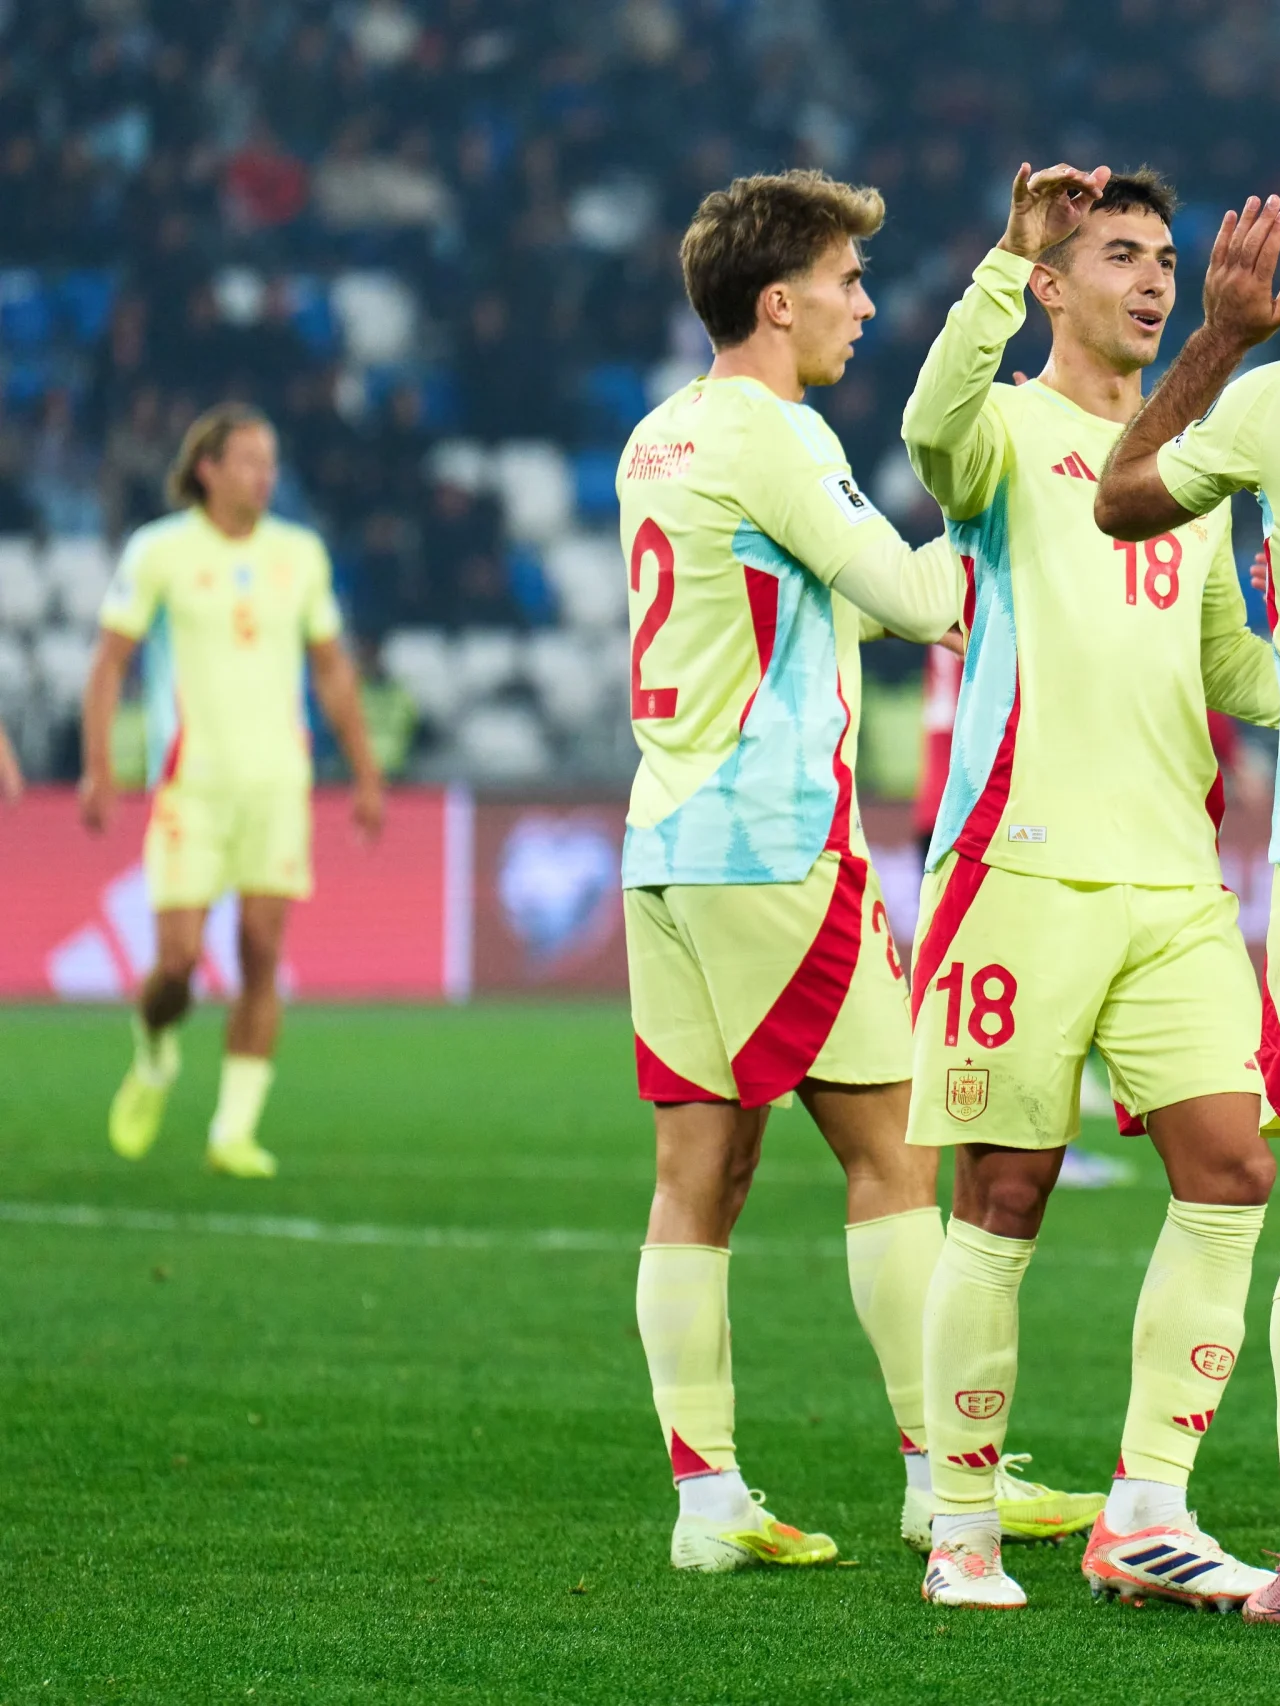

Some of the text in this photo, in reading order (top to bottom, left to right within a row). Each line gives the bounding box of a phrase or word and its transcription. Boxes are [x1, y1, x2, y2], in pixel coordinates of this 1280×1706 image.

[1113, 531, 1183, 610] 18
[631, 517, 678, 720] 2
[936, 961, 1017, 1049] 18
